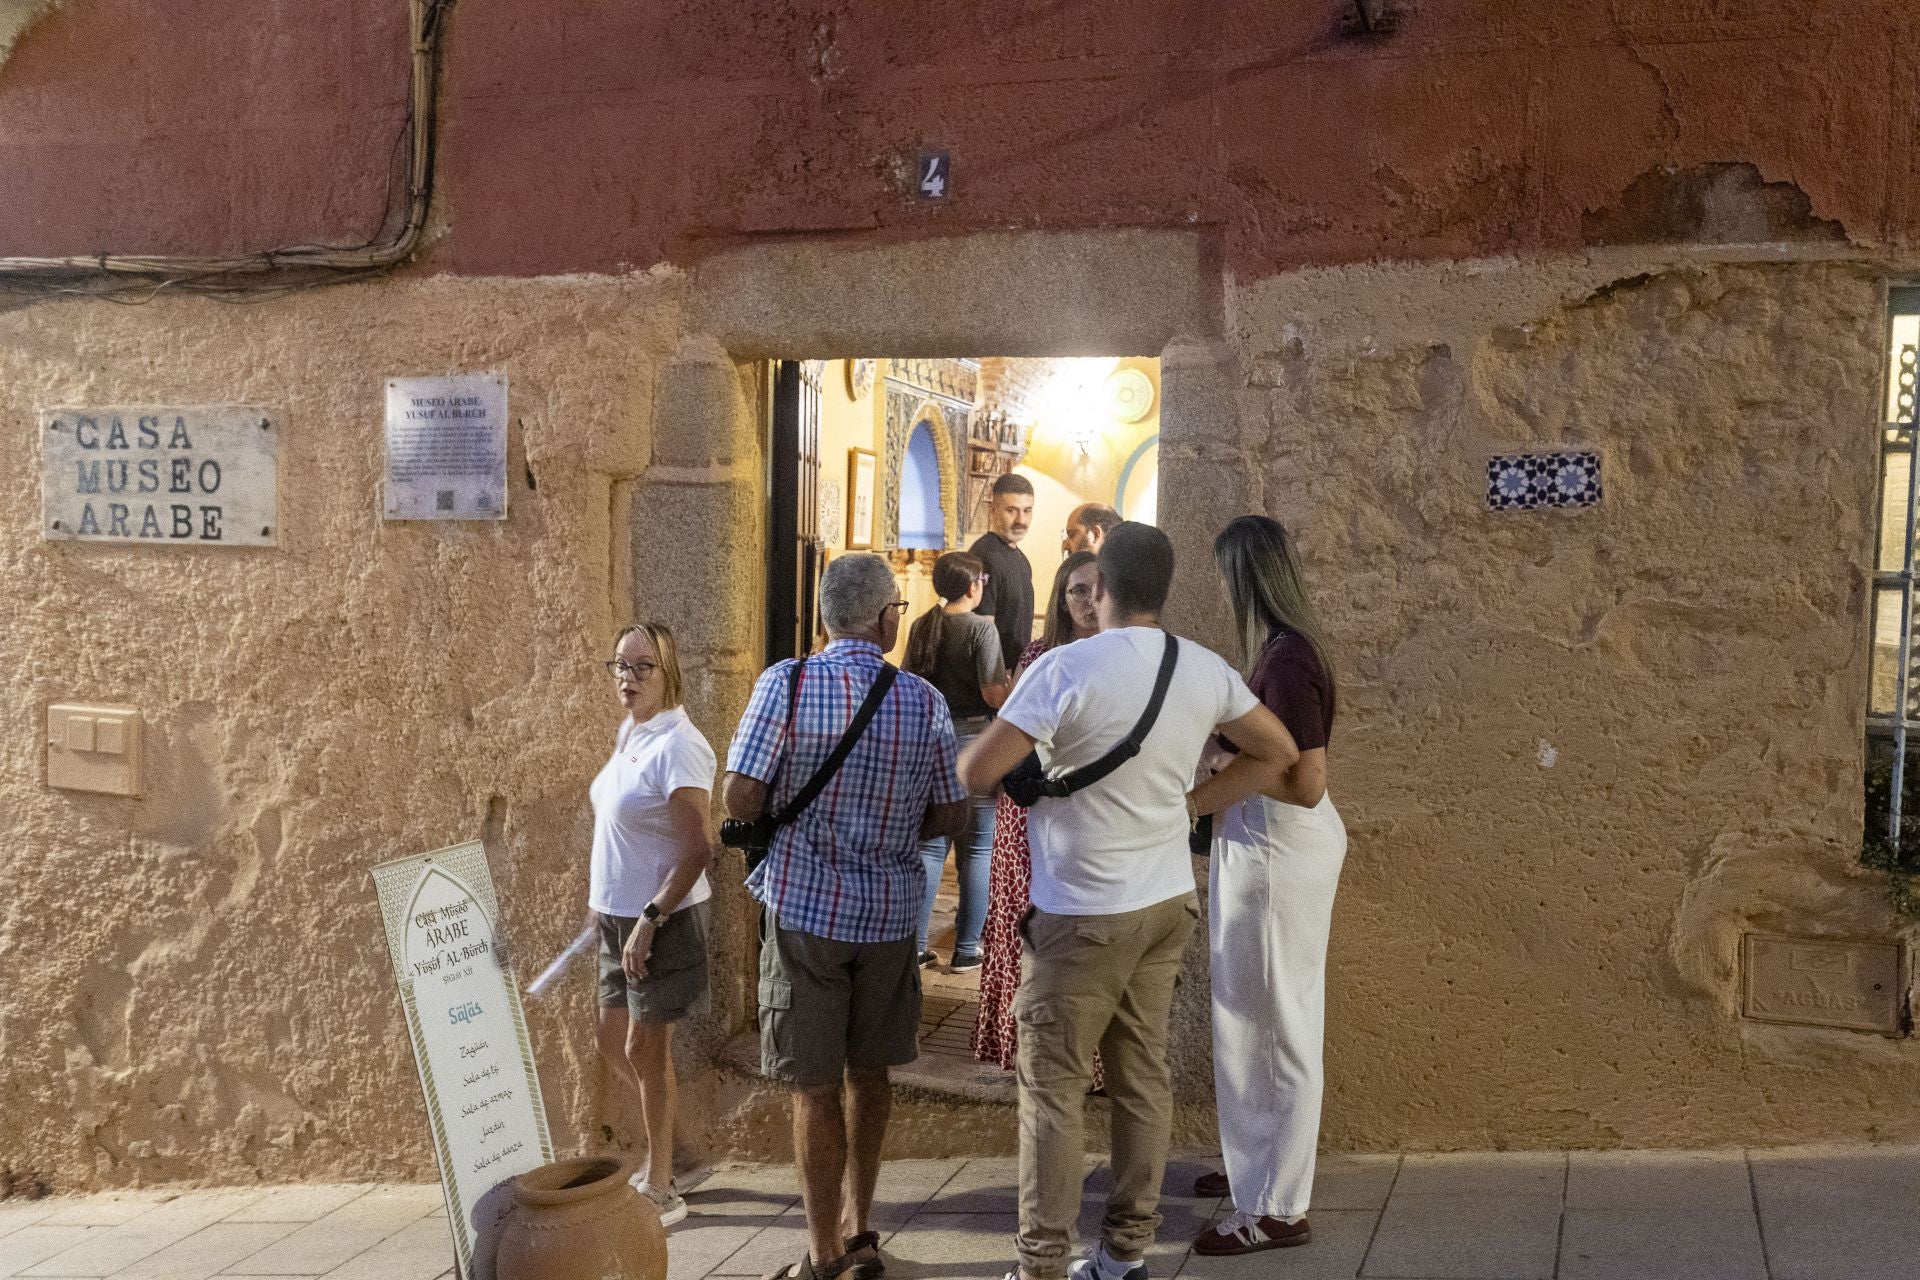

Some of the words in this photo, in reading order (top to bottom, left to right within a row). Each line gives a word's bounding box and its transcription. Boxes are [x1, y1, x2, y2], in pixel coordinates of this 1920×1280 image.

[921, 157, 944, 197] 4
[411, 398, 445, 407] MUSEO
[75, 415, 193, 450] CASA
[75, 457, 222, 495] MUSEO
[78, 503, 223, 541] ARABE
[415, 910, 437, 928] Casa
[440, 900, 468, 919] Museo
[414, 950, 445, 976] Yusuf
[463, 1072, 482, 1087] Sala
[461, 1103, 480, 1118] Sala
[473, 1156, 492, 1172] Sala
